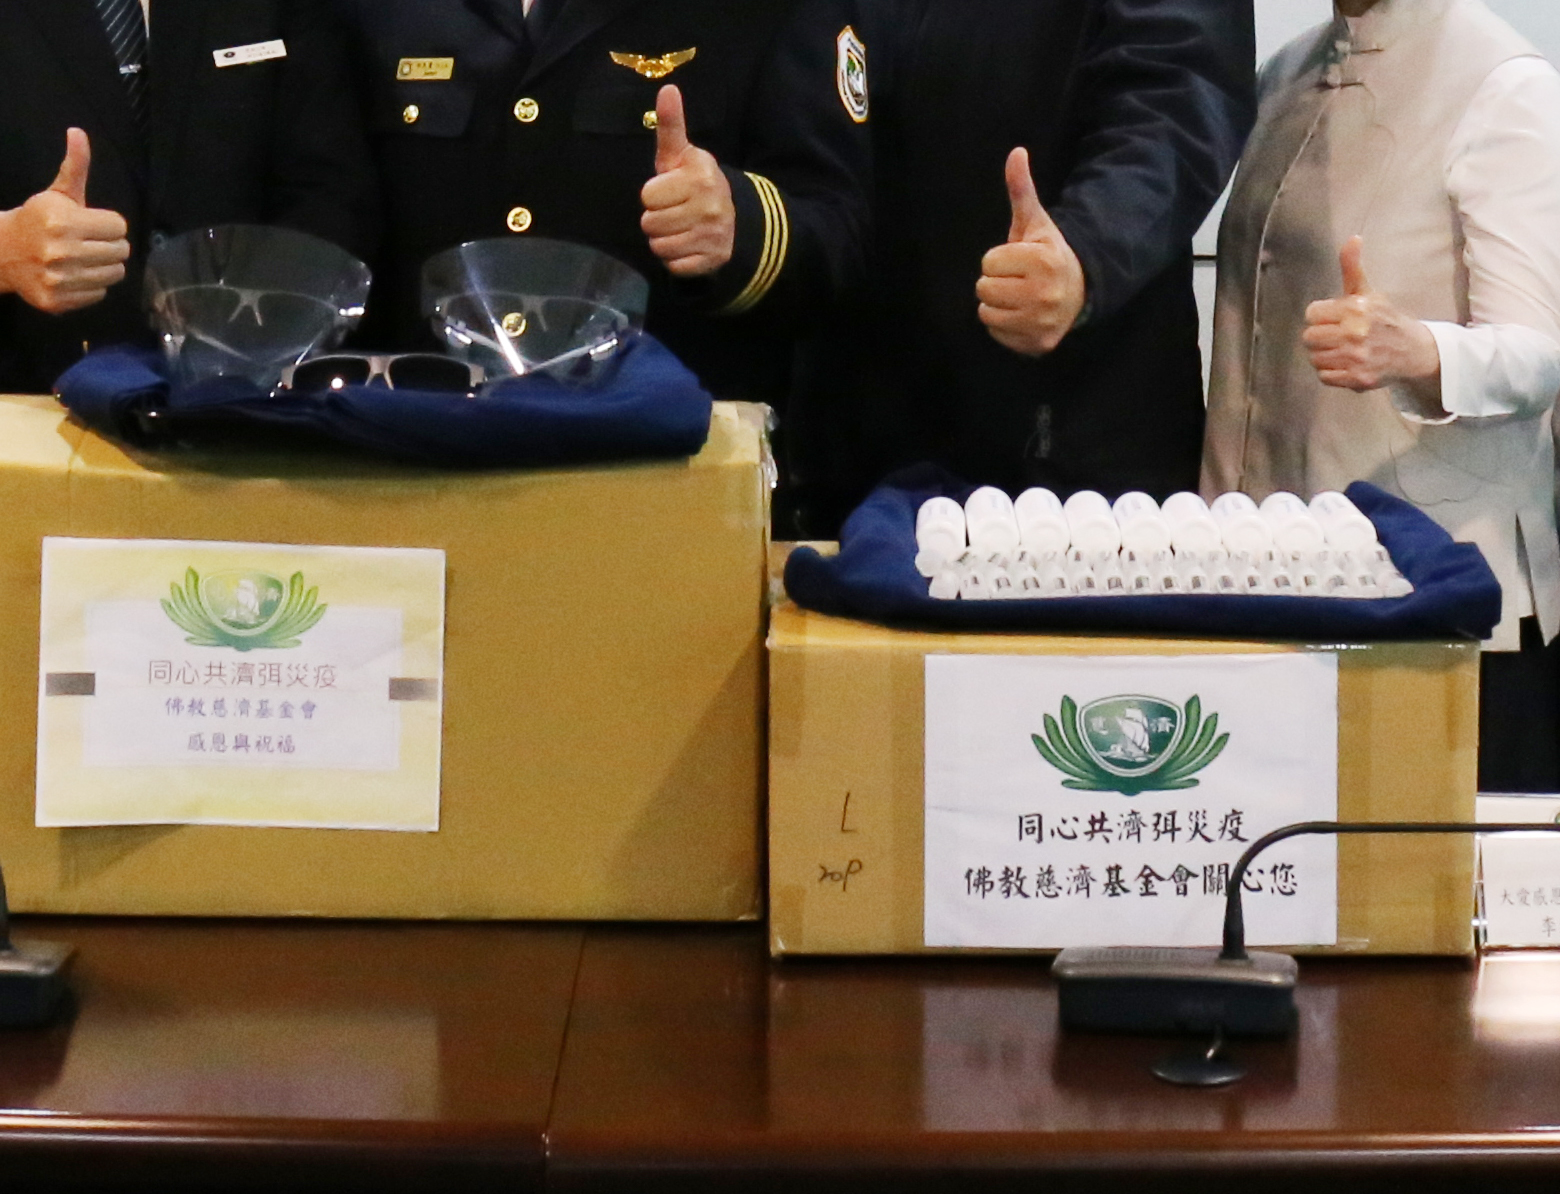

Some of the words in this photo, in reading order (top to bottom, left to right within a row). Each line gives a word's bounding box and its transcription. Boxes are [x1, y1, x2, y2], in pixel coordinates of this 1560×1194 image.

[147, 659, 338, 690] 同心共濟弭災疫
[164, 697, 317, 720] 佛教慈濟基金會
[186, 732, 297, 755] 感恩與祝福
[840, 791, 858, 834] L
[1017, 808, 1250, 844] 同心共濟弭災疫
[964, 863, 1299, 899] 佛教慈濟基金會關心您
